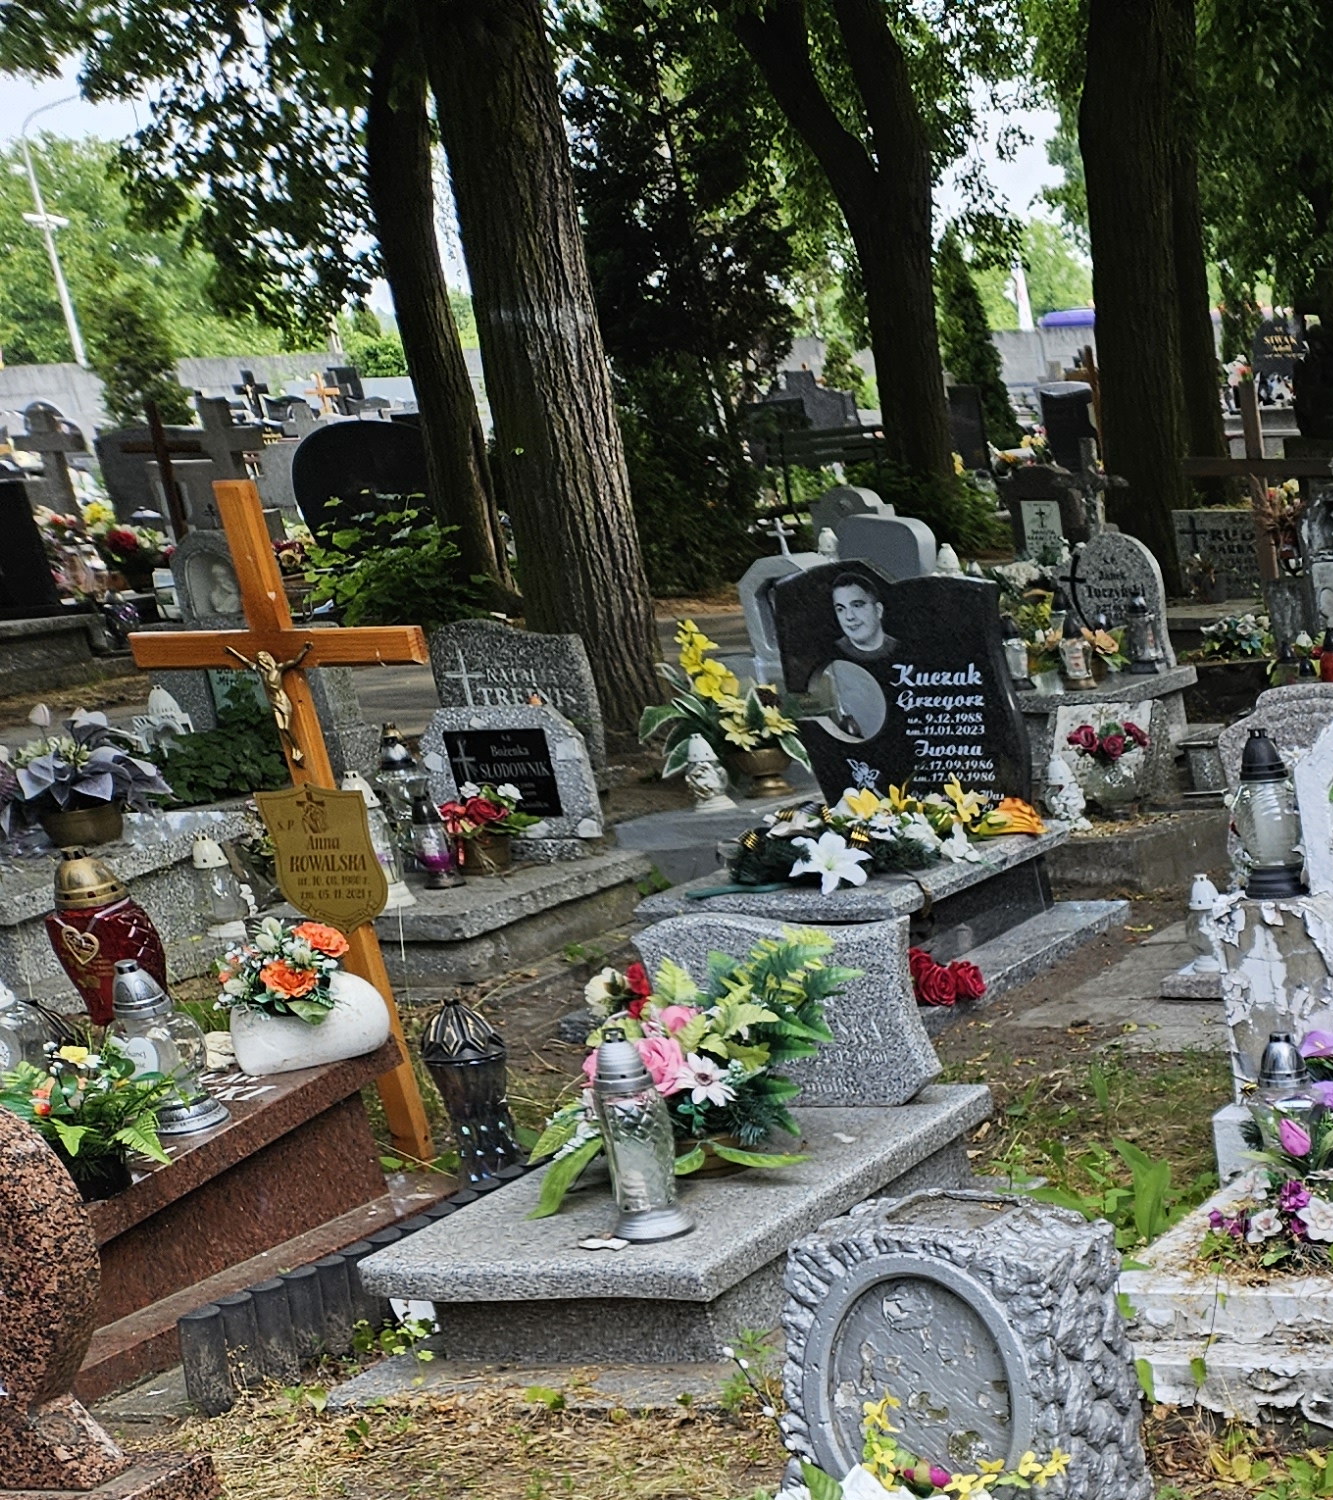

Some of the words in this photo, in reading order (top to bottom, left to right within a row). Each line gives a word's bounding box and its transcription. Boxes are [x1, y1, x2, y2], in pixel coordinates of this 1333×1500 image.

[889, 662, 983, 687] Kuczak
[895, 689, 985, 712] Grzegorz
[914, 739, 984, 757] Iwona
[307, 836, 340, 850] Anna
[290, 854, 367, 873] KOWALSKA
